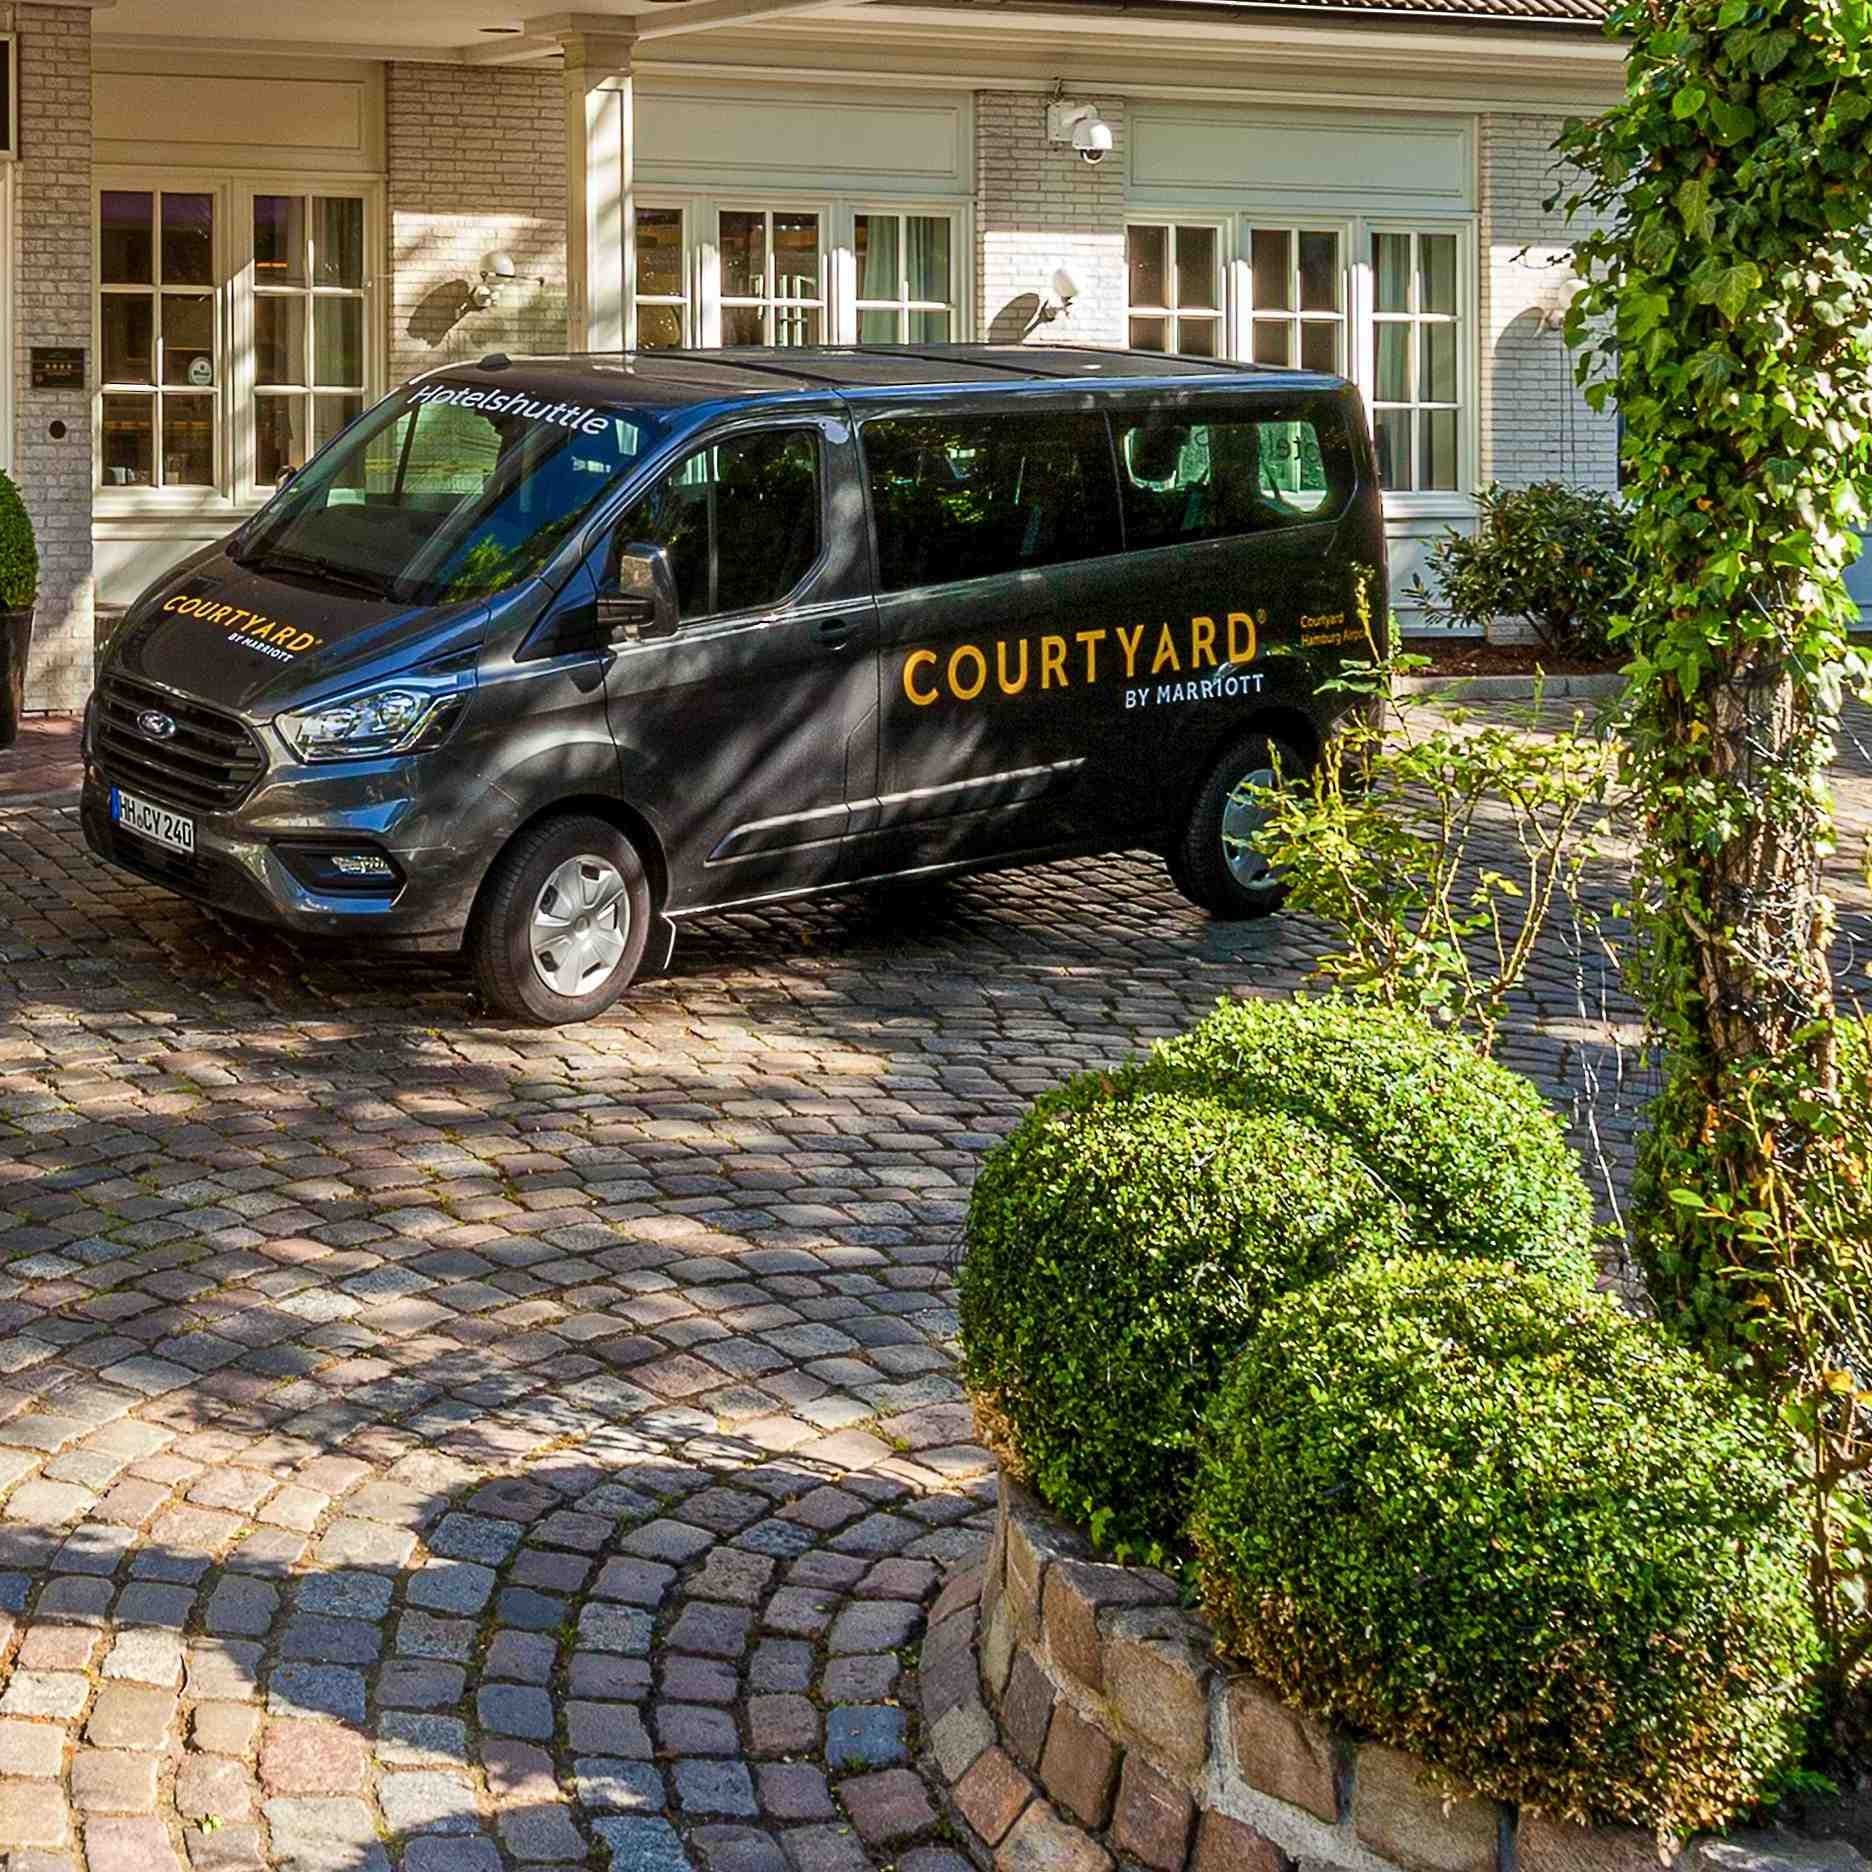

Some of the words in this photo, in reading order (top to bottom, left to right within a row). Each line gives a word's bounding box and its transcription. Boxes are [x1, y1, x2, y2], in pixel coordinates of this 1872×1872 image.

[407, 385, 609, 435] Hotelshuttle
[228, 632, 244, 642] BY
[241, 635, 295, 663] MARRIOTT
[1125, 690, 1149, 709] BY
[1156, 674, 1264, 705] MARRIOTT
